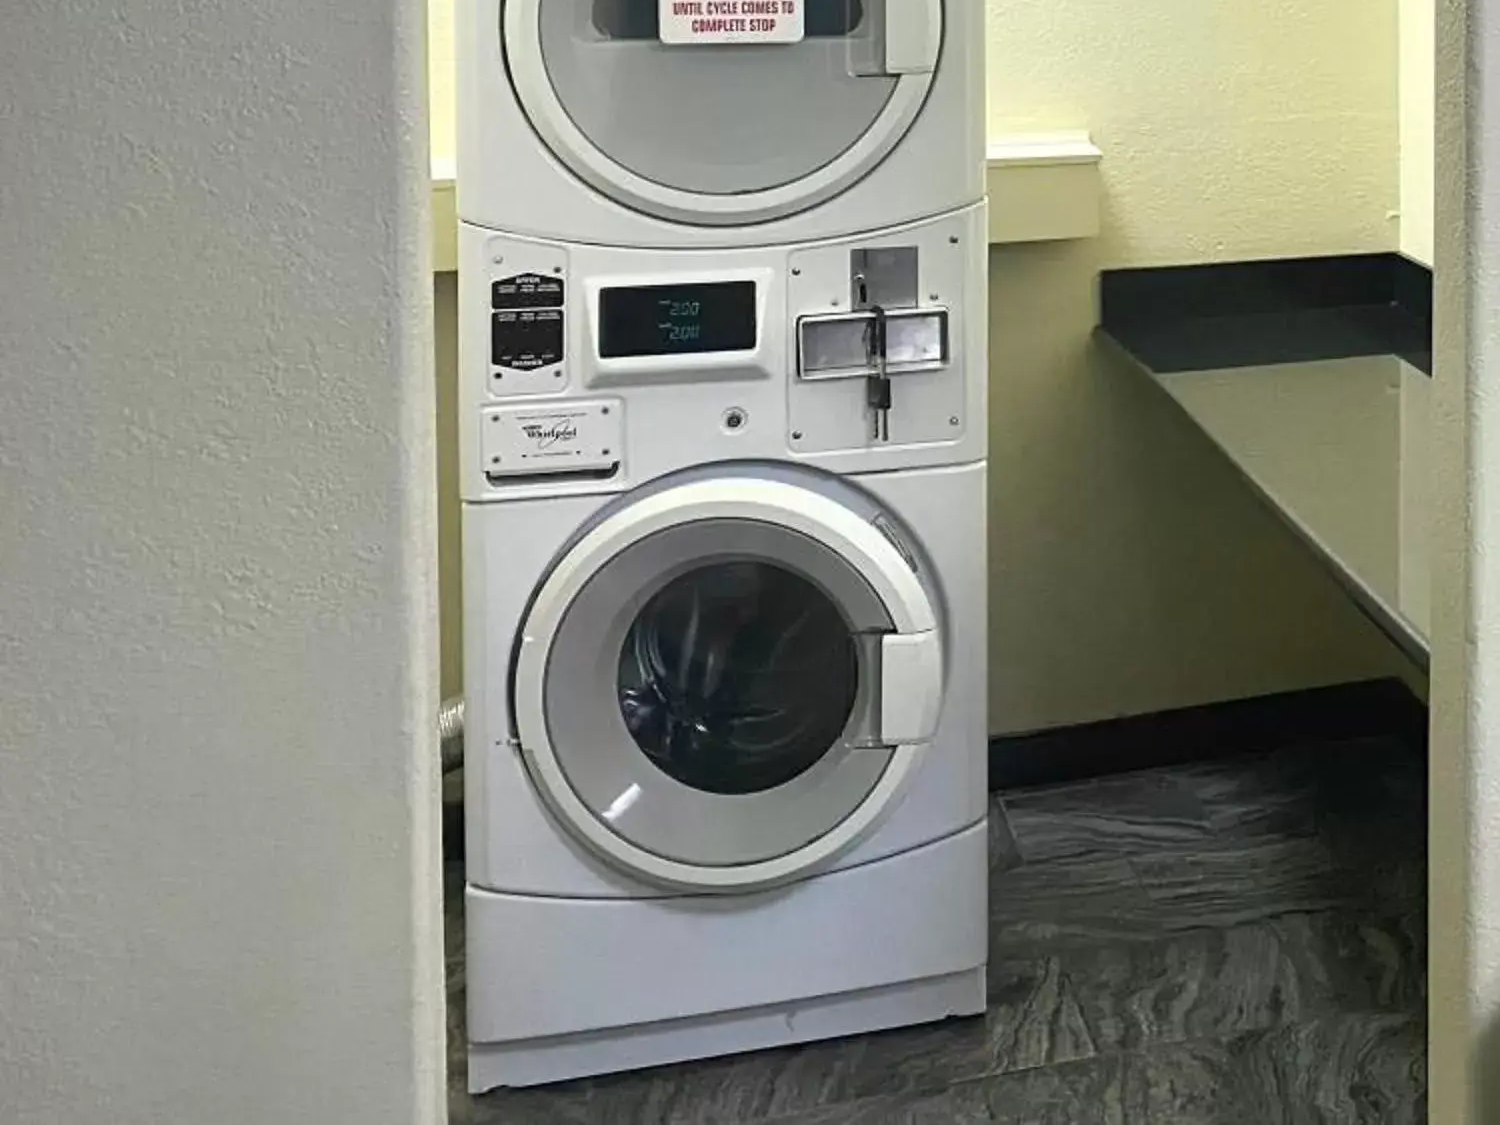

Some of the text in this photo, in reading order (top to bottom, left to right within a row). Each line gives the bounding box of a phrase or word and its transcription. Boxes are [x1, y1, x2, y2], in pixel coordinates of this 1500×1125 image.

[672, 1, 794, 16] UNTIL CYCLE COMES TO
[692, 18, 777, 33] COMPLETE STOP
